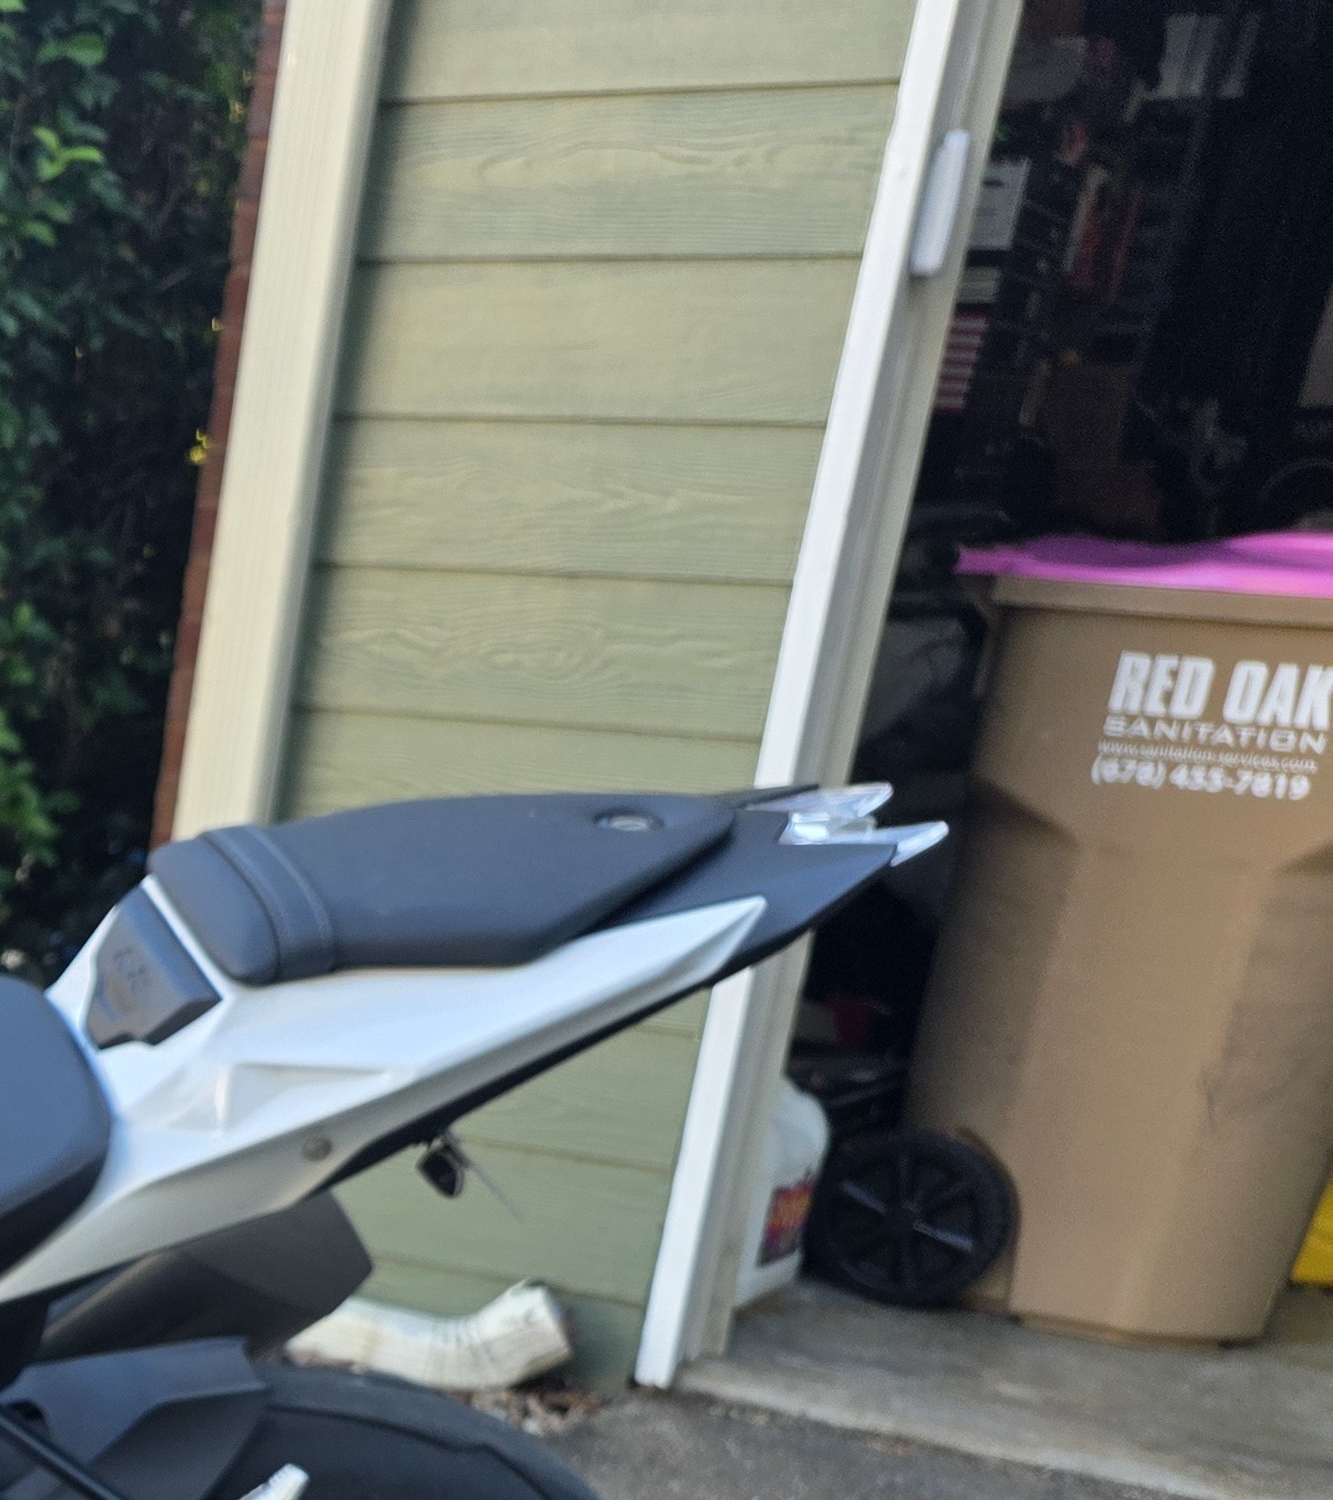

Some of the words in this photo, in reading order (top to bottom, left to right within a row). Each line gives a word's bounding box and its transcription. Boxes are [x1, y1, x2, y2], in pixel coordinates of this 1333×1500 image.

[1108, 650, 1215, 719] RED
[1222, 660, 1333, 731] OAK
[1103, 714, 1326, 755] SANITATION
